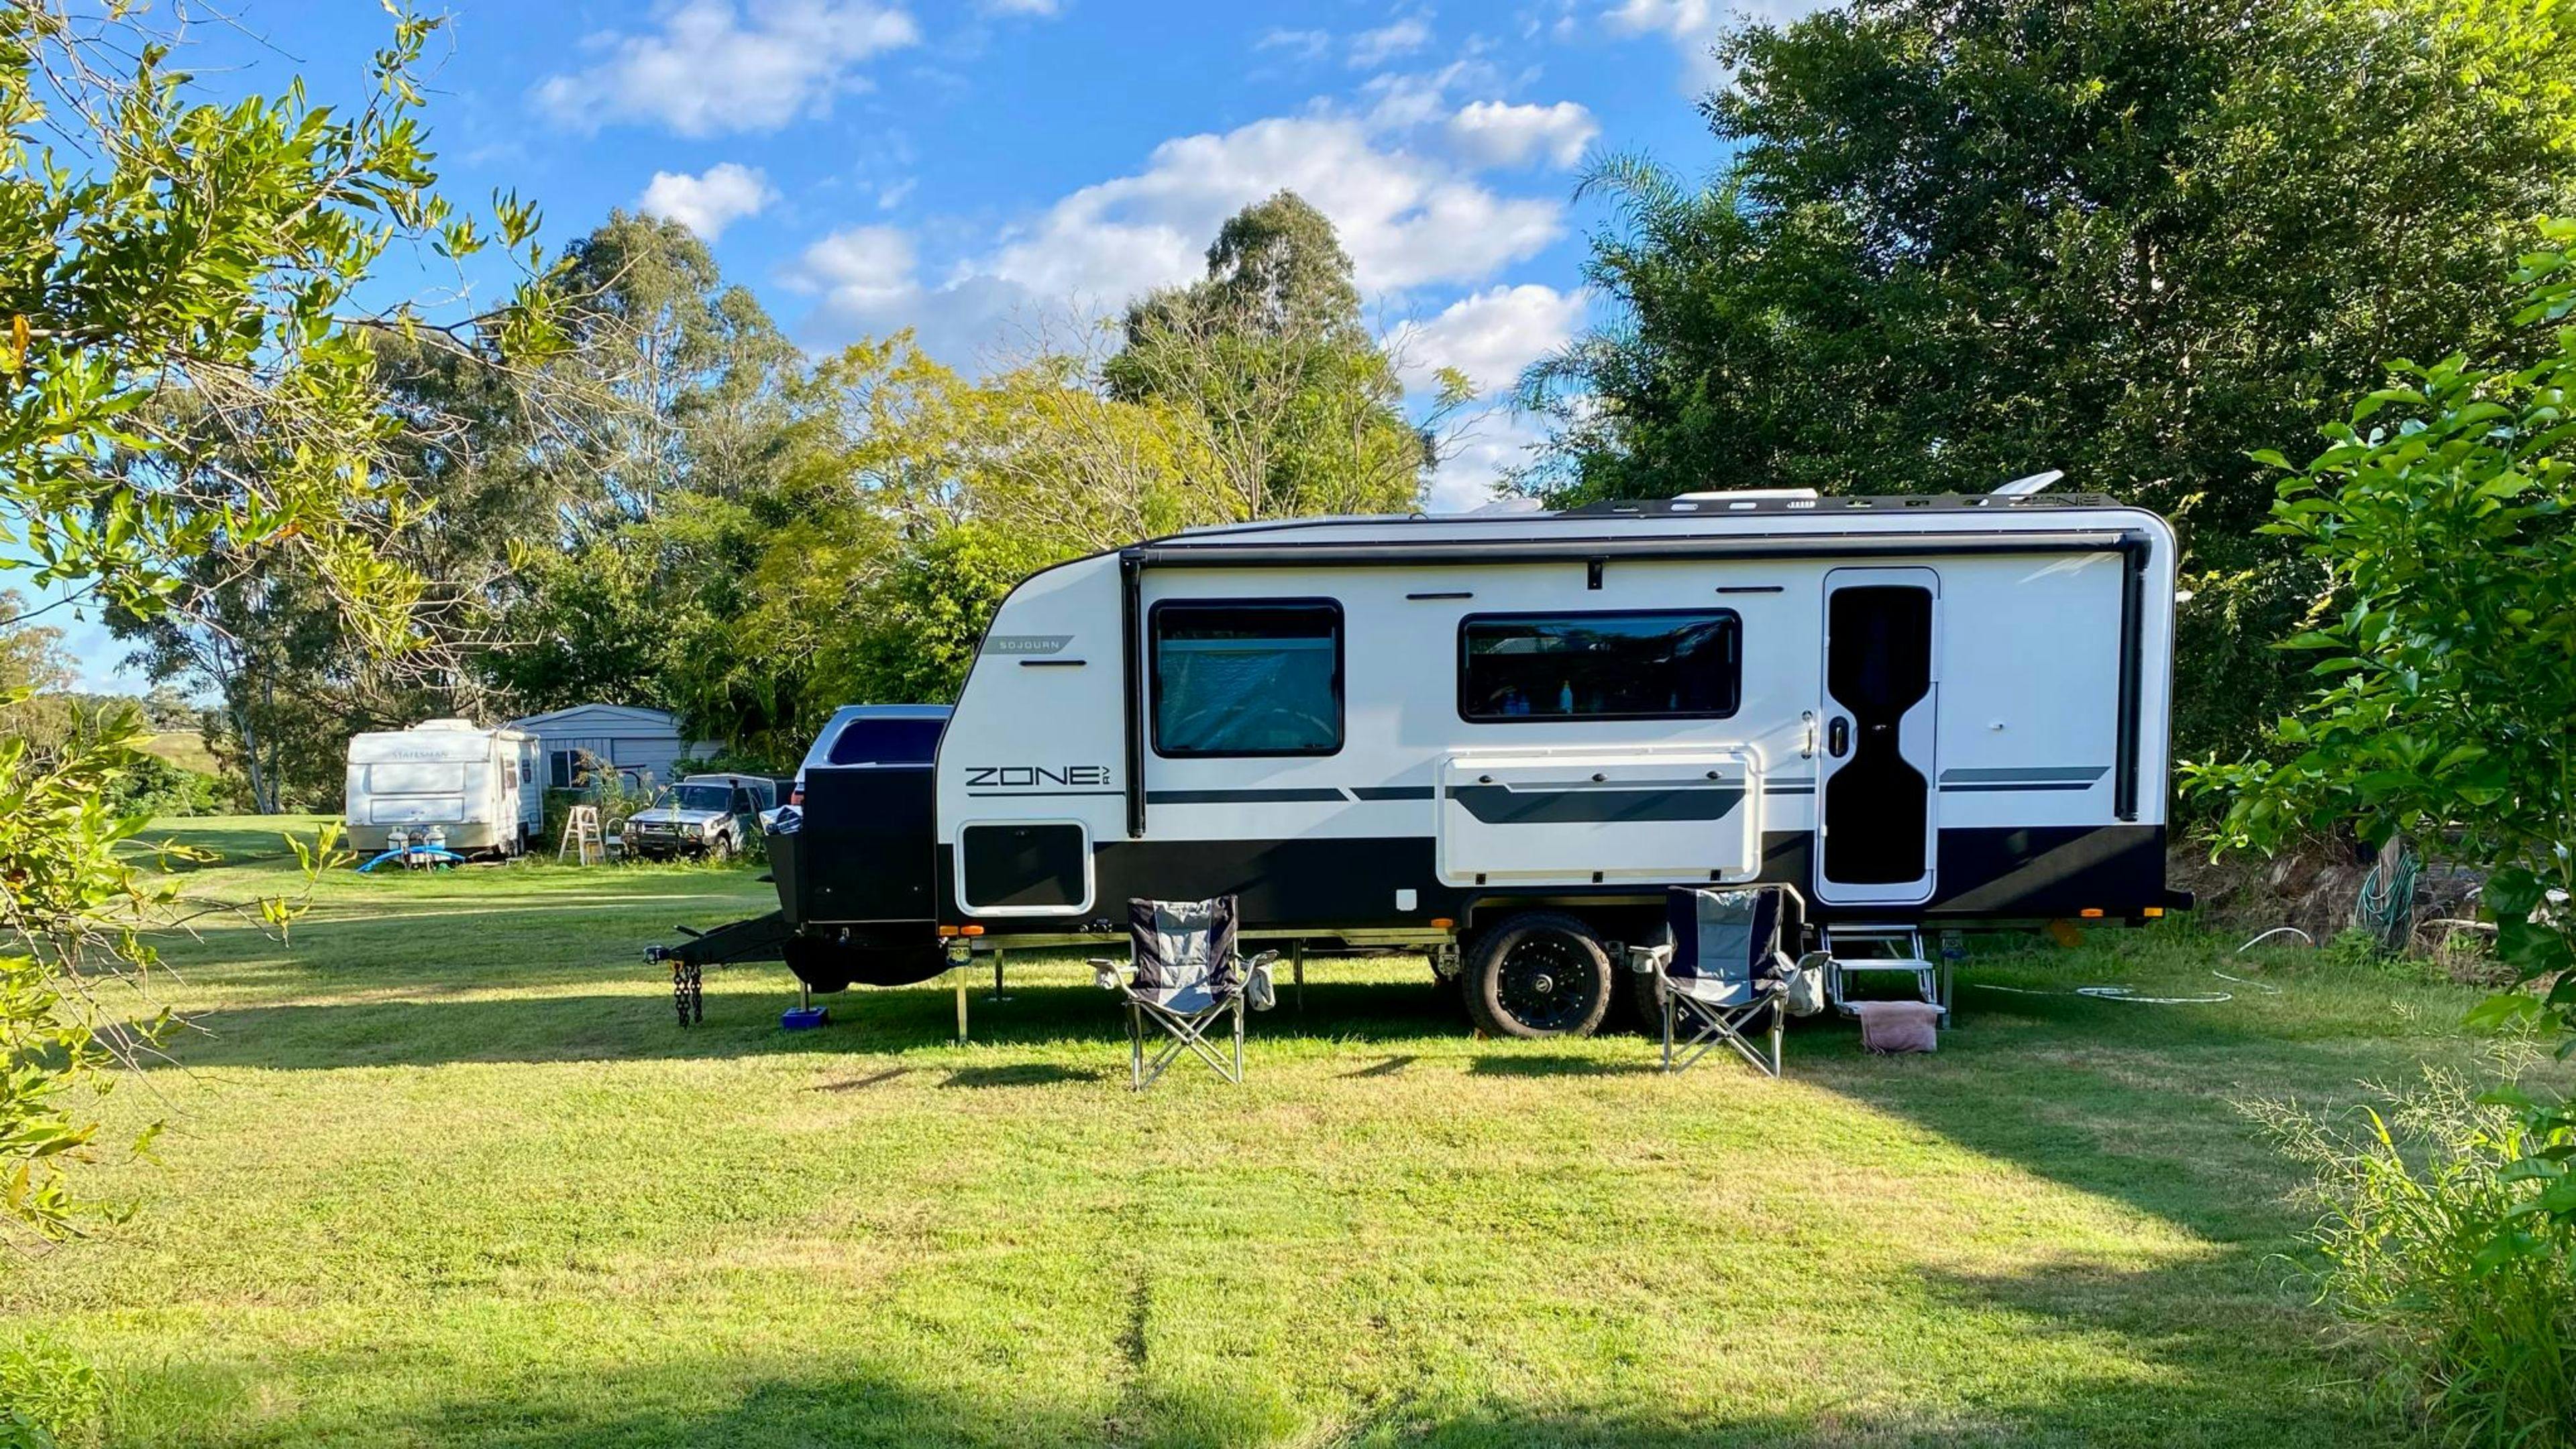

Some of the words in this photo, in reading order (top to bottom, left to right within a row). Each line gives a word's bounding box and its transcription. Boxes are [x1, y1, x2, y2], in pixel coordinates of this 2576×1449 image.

[999, 641, 1059, 649] SOJOURN
[965, 765, 1100, 786] ZONE
[1102, 766, 1110, 785] RV
